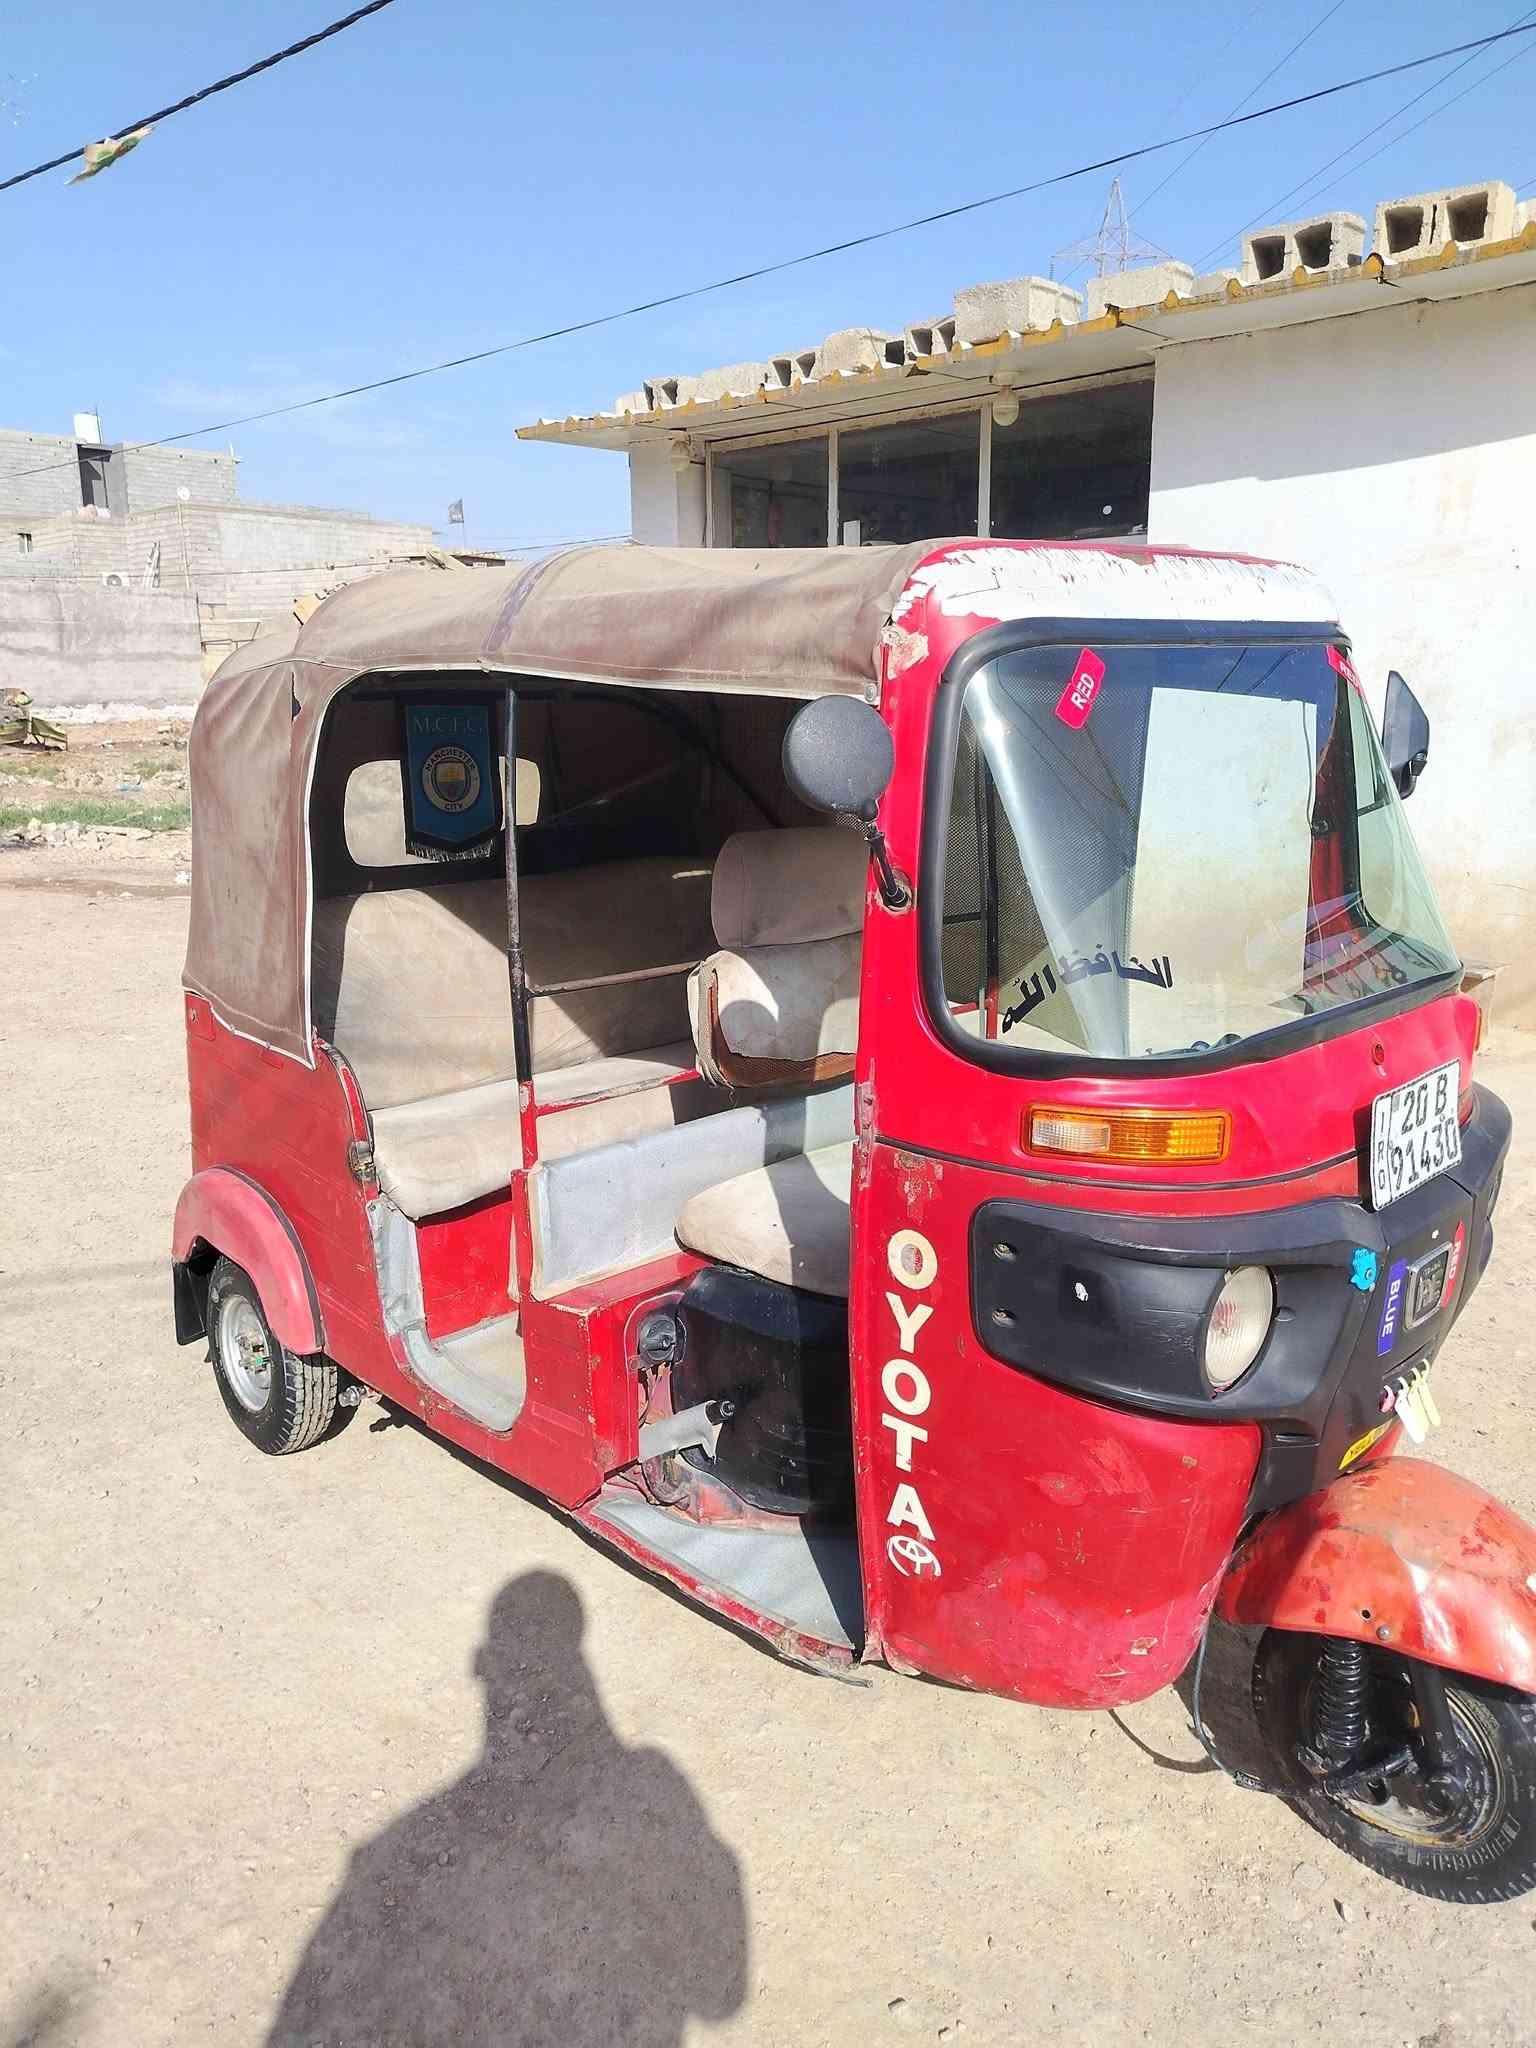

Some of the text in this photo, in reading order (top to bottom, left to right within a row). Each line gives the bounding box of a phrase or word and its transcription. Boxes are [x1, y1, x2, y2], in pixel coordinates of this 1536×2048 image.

[1071, 673, 1095, 710] RED
[444, 802, 464, 812] CITY
[1401, 1073, 1448, 1135] 20 B
[1391, 1116, 1459, 1191] 91430
[1448, 1240, 1462, 1280] RED
[1381, 1279, 1401, 1337] BLUE
[881, 1229, 938, 1541] OYOTA
